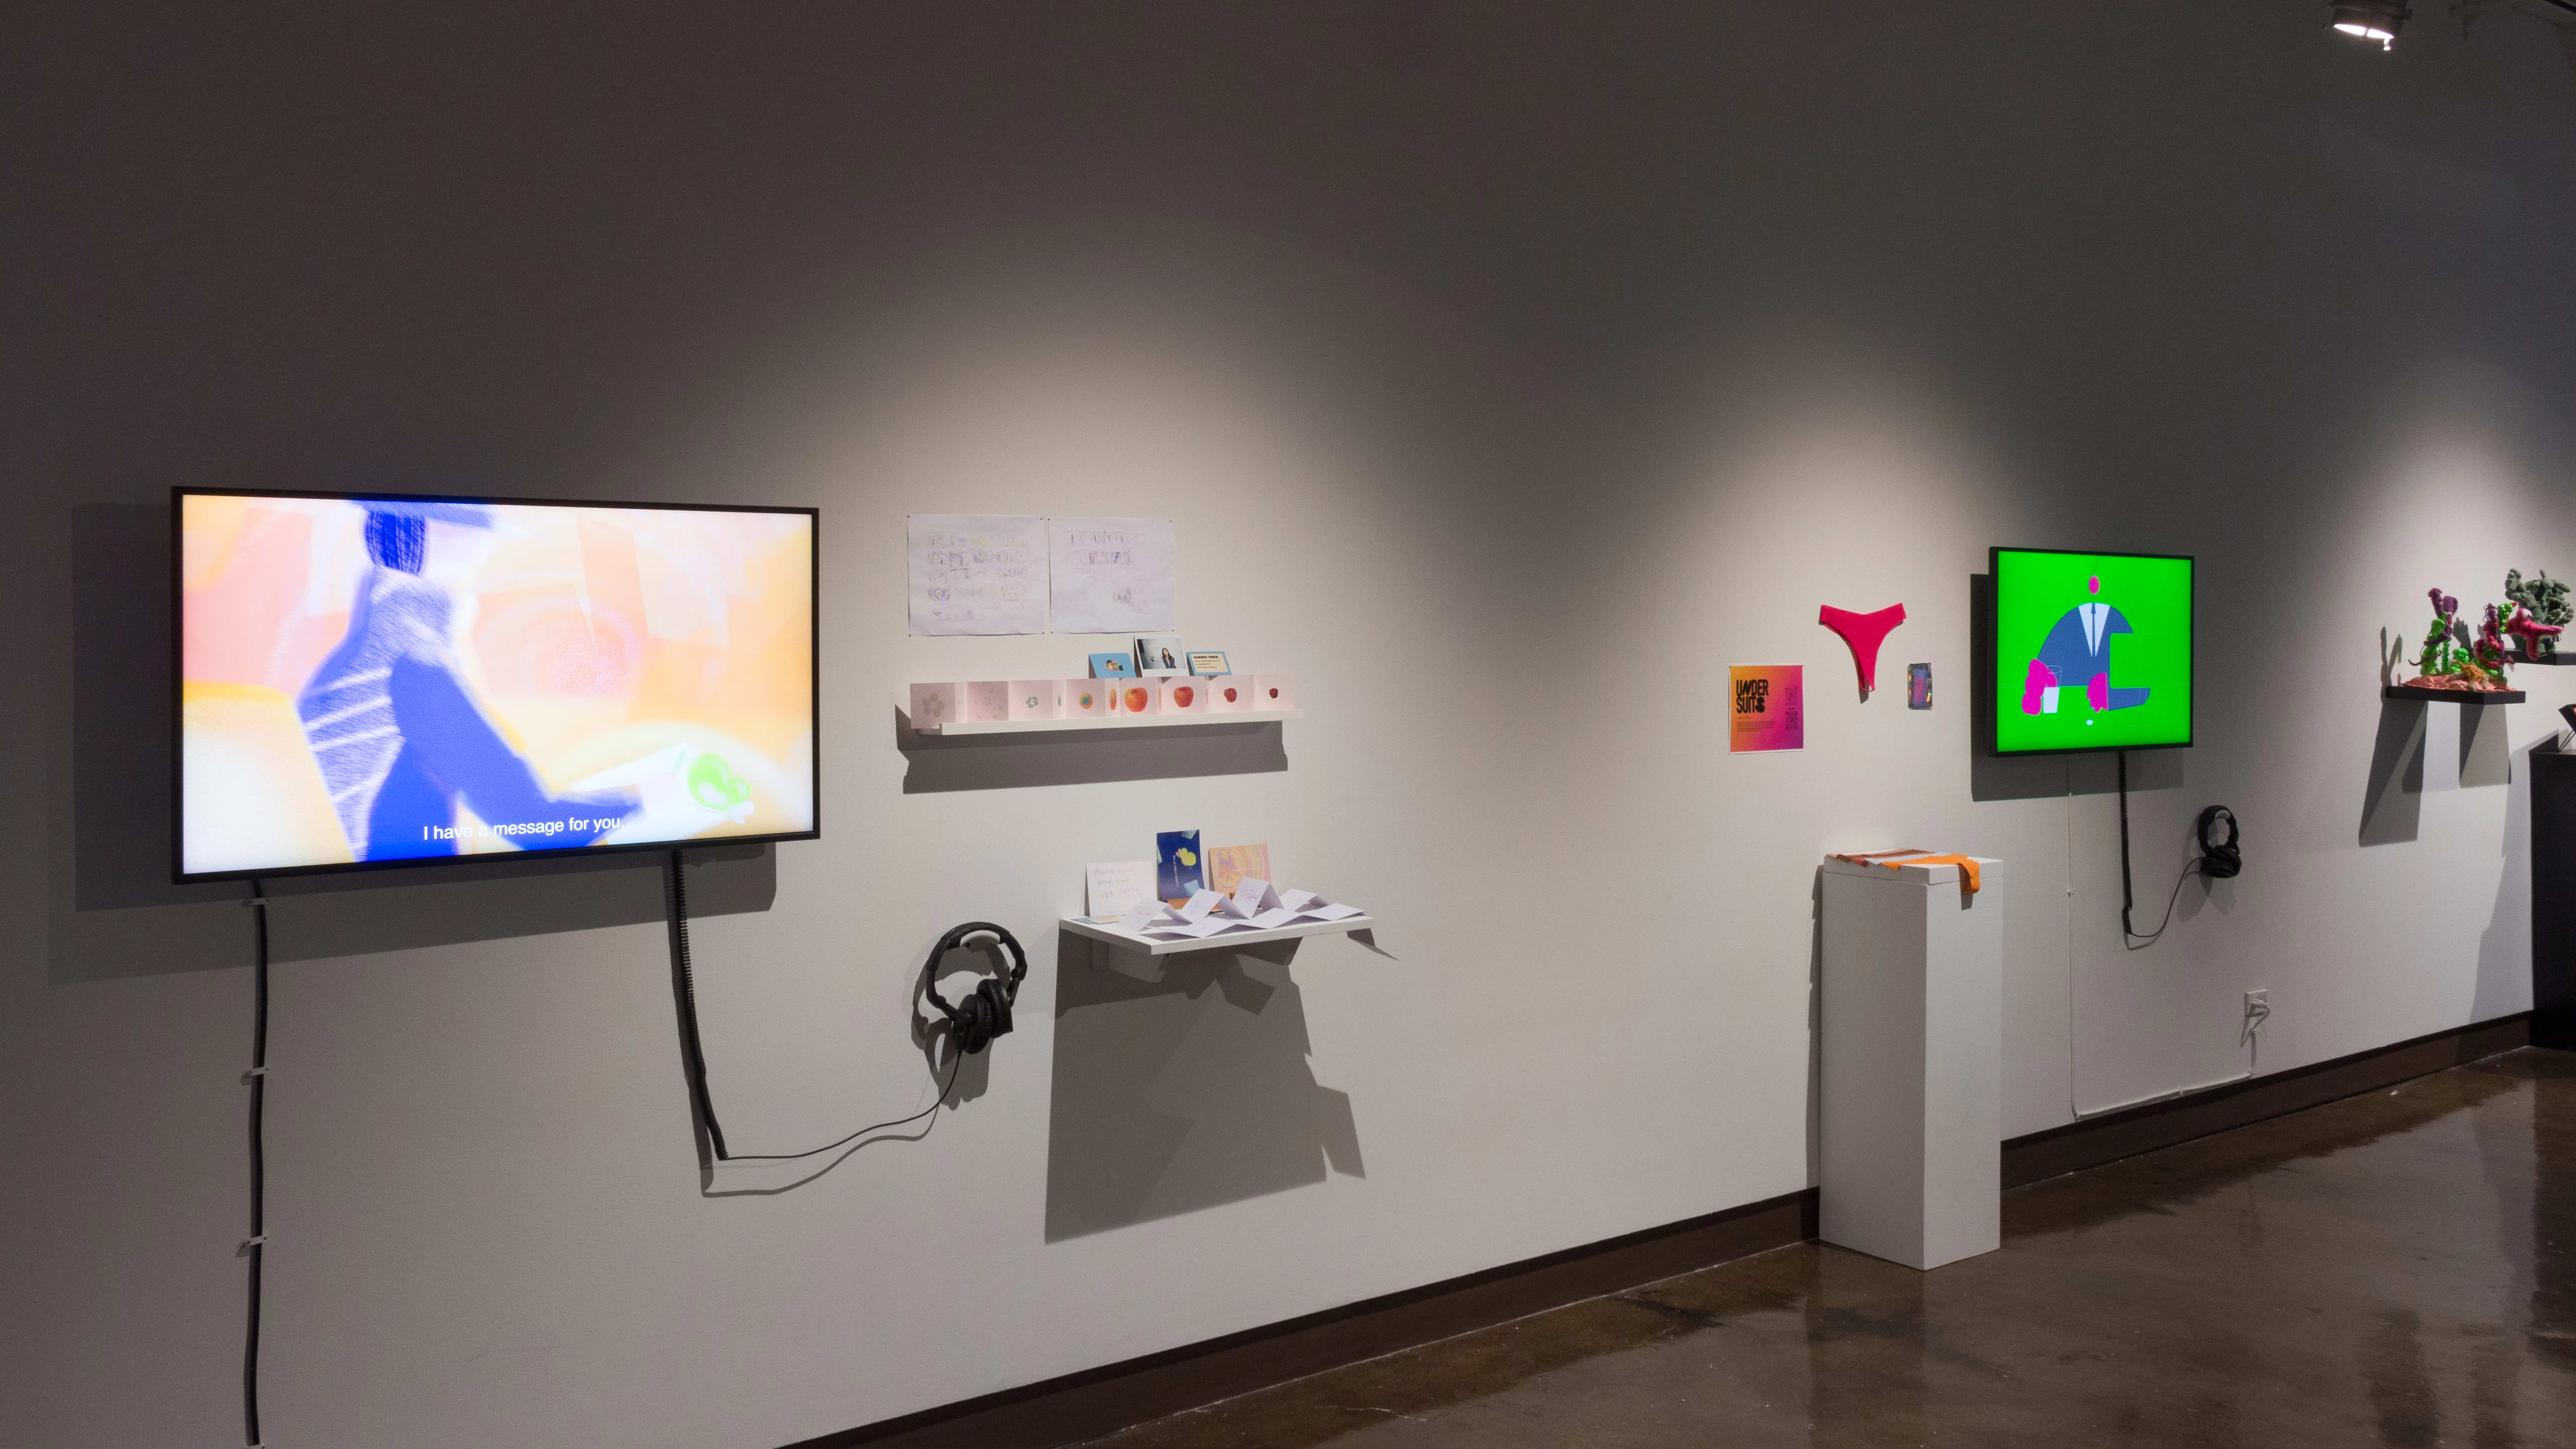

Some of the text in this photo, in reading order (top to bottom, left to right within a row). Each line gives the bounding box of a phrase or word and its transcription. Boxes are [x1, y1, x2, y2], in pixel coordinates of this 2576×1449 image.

[1736, 679, 1769, 696] UNDER
[1736, 696, 1766, 714] SUITS
[424, 825, 428, 840] I
[433, 825, 474, 840] have
[478, 825, 488, 837] a
[493, 820, 564, 836] message
[568, 817, 590, 831] for
